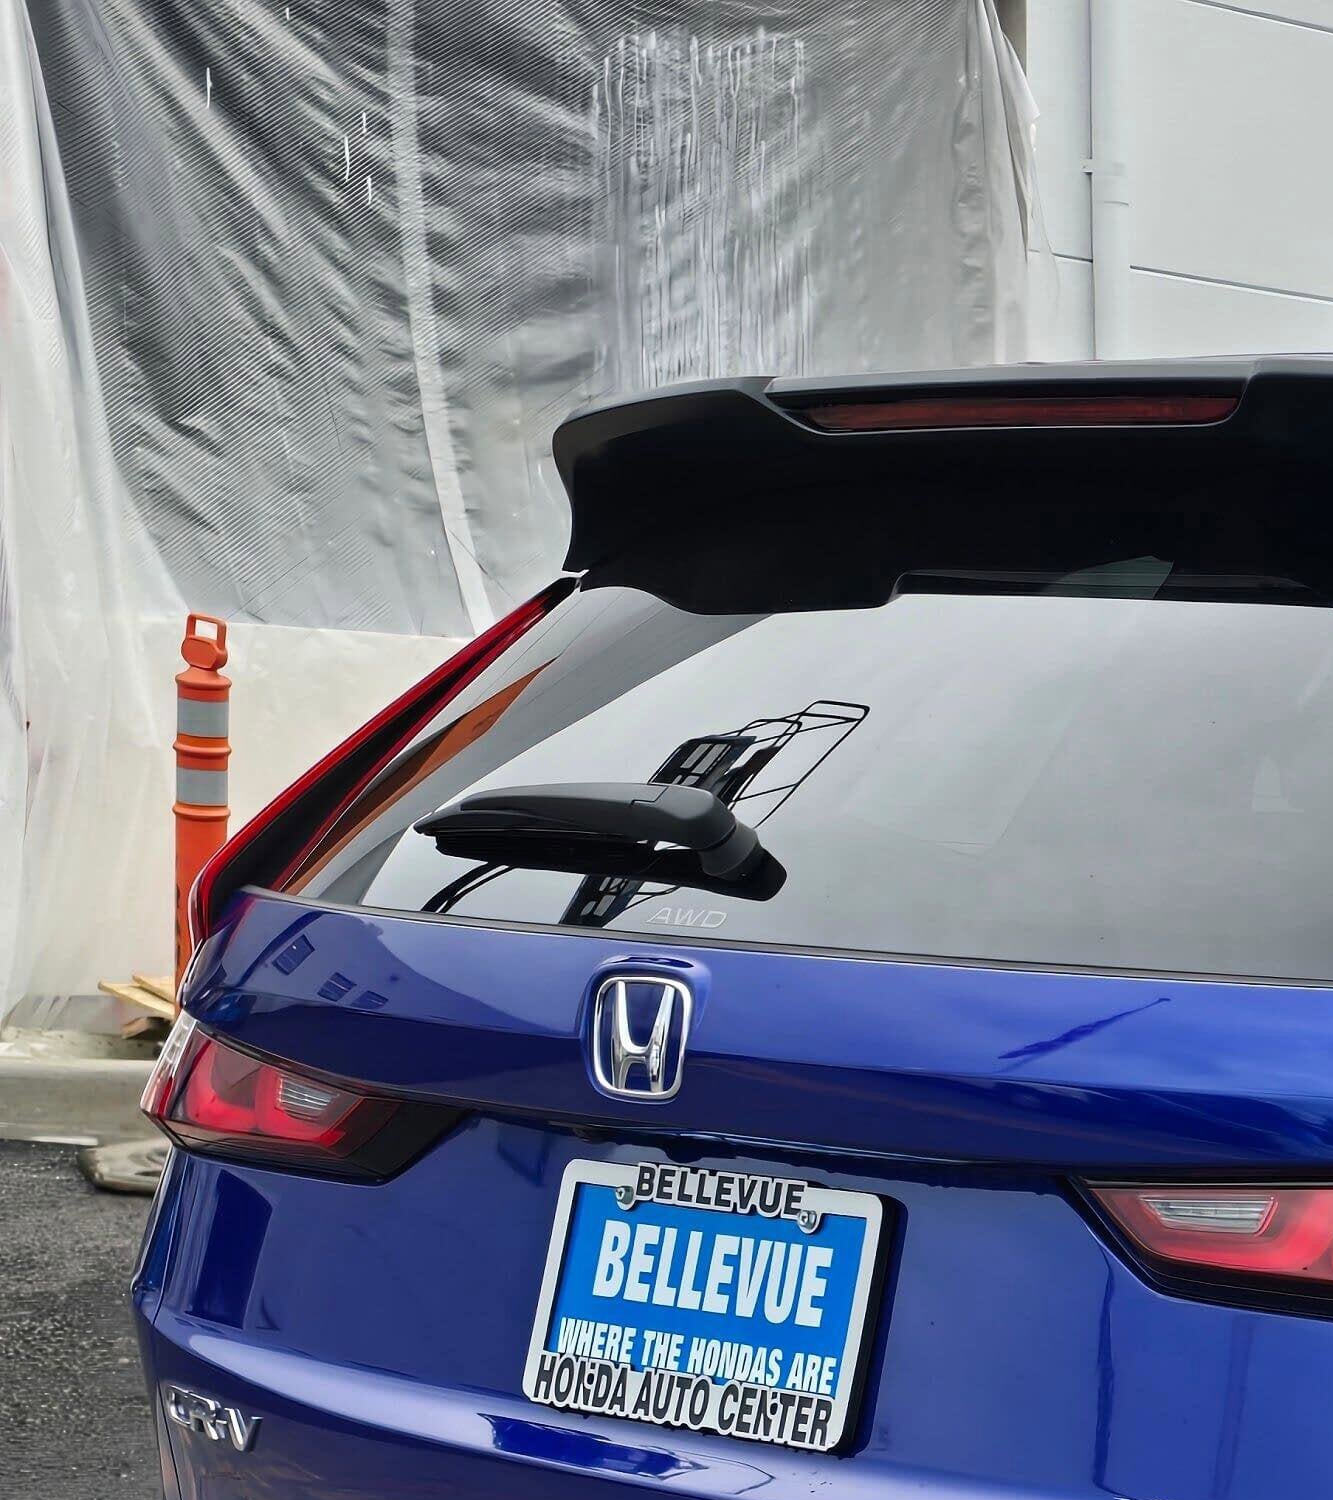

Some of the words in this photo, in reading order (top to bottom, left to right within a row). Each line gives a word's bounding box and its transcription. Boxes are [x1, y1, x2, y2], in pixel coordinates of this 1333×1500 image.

[646, 907, 728, 928] AWD
[636, 1165, 806, 1215] BELLEVUE
[592, 1219, 834, 1328] BELLEVUE
[557, 1317, 637, 1364] WHERE
[641, 1330, 685, 1371] THE
[686, 1336, 783, 1387] HONDAS
[785, 1352, 838, 1395] ARE
[533, 1354, 629, 1412] HONDA
[632, 1371, 711, 1426] AUTO
[718, 1383, 833, 1447] CENTER
